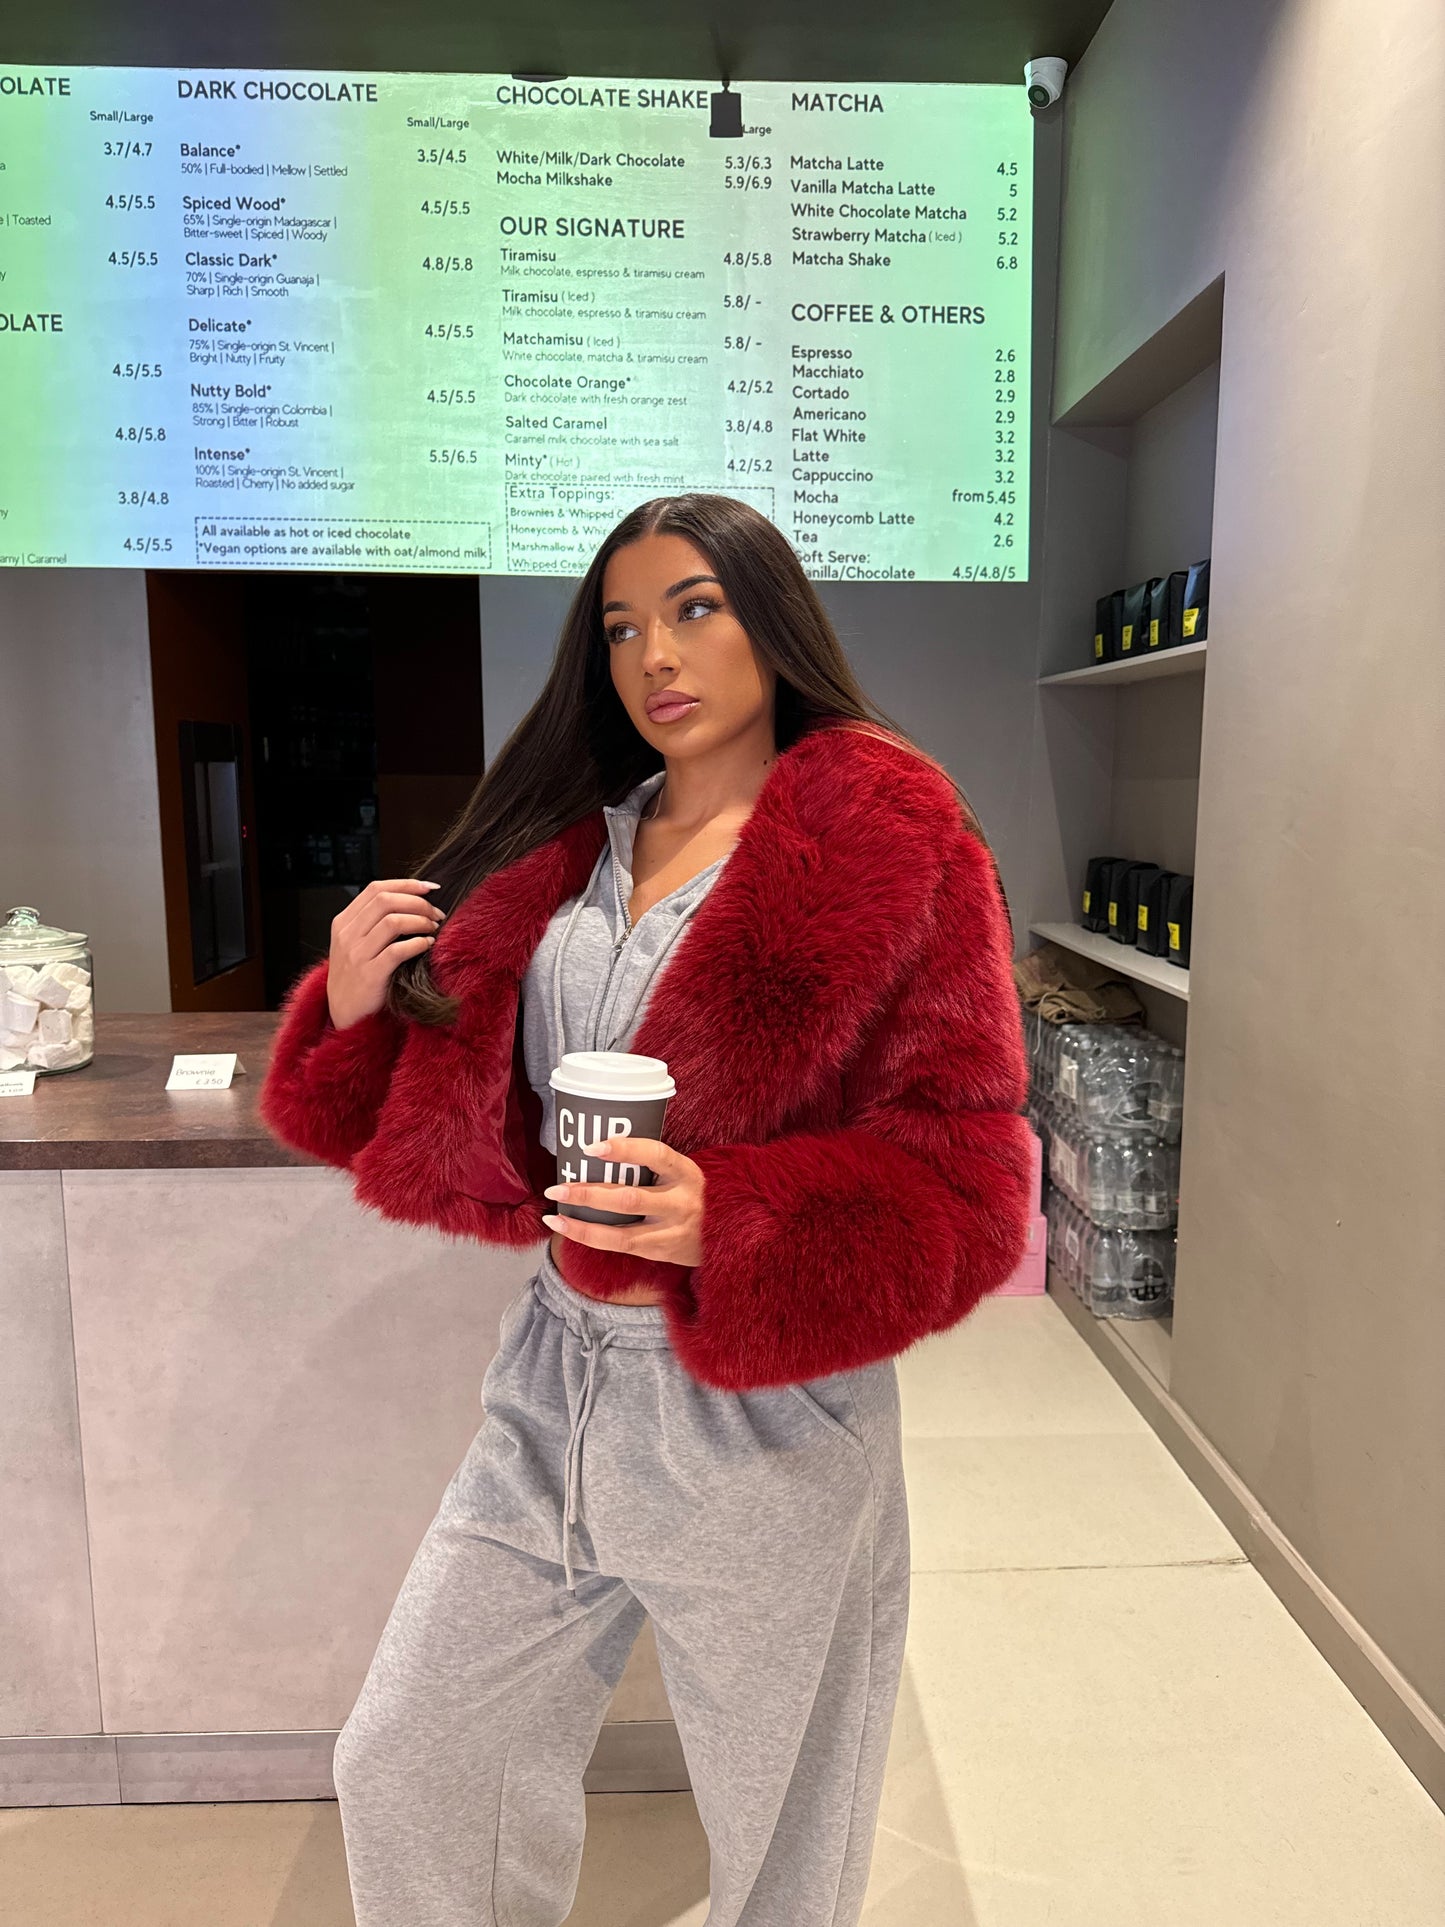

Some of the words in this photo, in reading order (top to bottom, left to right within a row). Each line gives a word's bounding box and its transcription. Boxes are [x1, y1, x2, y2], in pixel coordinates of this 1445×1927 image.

[178, 80, 236, 99] DARK
[244, 81, 377, 102] CHOCOLATE
[497, 86, 630, 107] CHOCOLATE
[638, 89, 708, 109] SHAKE
[792, 93, 883, 112] MATCHA
[90, 111, 153, 125] Small/Large
[407, 117, 469, 131] Small/Large
[104, 142, 152, 158] 3.7/4.7
[418, 148, 466, 165] 3.5/4.5
[496, 150, 611, 167] White/Milk/Dark
[616, 153, 685, 167] Chocolate
[725, 155, 771, 172] 5.3/6.3
[791, 156, 842, 170] Matcha
[848, 157, 884, 170] Latte
[181, 163, 202, 174] 50%
[210, 163, 264, 175] Full-bodied
[272, 164, 306, 175] Mellow
[314, 165, 347, 176] Settled
[997, 162, 1017, 176] 4.5
[497, 171, 541, 184] Mocha
[546, 172, 613, 186] Milkshake
[725, 175, 771, 191] 5.9/6.9
[791, 179, 836, 193] Vanilla
[842, 181, 893, 194] Matcha
[899, 182, 935, 195] Latte
[1010, 184, 1017, 197] 5
[106, 194, 155, 211] 4.5/5.5
[183, 196, 231, 213] Spiced
[421, 200, 470, 216] 4.5/5.5
[791, 203, 834, 217] White
[839, 204, 910, 219] Chocolate
[915, 206, 966, 219] Matcha
[997, 208, 1016, 221] 5.2
[184, 214, 205, 225] 65%
[212, 215, 272, 229] Single-origin
[274, 216, 331, 231] Madagascar
[500, 216, 547, 236] OUR
[556, 218, 684, 238] SIGNATURE
[184, 227, 243, 238] Bitter-sweet
[251, 228, 284, 241] Spiced
[291, 228, 327, 242] Woody
[792, 227, 870, 245] Strawberry
[875, 228, 926, 242] Matcha
[999, 232, 1018, 245] 5.2
[109, 251, 158, 268] 4.5/5.5
[186, 252, 234, 266] Classic
[500, 248, 556, 262] Tiramisu
[724, 252, 772, 268] 4.8/5.8
[793, 251, 843, 265] Matcha
[849, 252, 891, 266] Shake
[997, 256, 1017, 269] 6.8
[423, 256, 473, 273] 4.8/5.8
[501, 265, 520, 276] Milk
[576, 269, 620, 279] espresso
[634, 269, 671, 278] tiramisu
[675, 271, 705, 279] cream
[186, 271, 207, 283] 70%
[215, 272, 274, 286] Single-origin
[276, 273, 314, 287] Guanaja
[187, 284, 215, 298] Sharp
[223, 285, 243, 296] Rich
[251, 285, 289, 297] Smooth
[502, 289, 558, 302] Tiramisu
[792, 304, 873, 322] COFFEE
[880, 305, 895, 323] &
[902, 306, 985, 324] OTHERS
[425, 324, 473, 340] 4.5/5.5
[504, 332, 583, 345] Matchamisu
[792, 345, 852, 362] Espresso
[996, 349, 1015, 362] 2.6
[113, 363, 162, 380] 4.5/5.5
[793, 365, 864, 379] Macchiato
[995, 370, 1015, 383] 2.8
[504, 375, 572, 388] Chocolate
[728, 379, 773, 395] 4.2/5.2
[191, 384, 230, 400] Nutty
[427, 389, 475, 405] 4.5/5.5
[505, 392, 526, 402] Dark
[530, 393, 577, 404] chocolate
[580, 394, 601, 404] with
[604, 394, 628, 404] fresh
[667, 397, 687, 405] zest
[792, 386, 849, 399] Cortado
[996, 389, 1015, 403] 2.9
[793, 407, 866, 420] Americano
[996, 410, 1015, 423] 2.9
[193, 415, 225, 429] Strong
[233, 415, 257, 426] Bitter
[266, 416, 298, 427] Robust
[506, 415, 547, 428] Salted
[553, 416, 607, 429] Caramel
[726, 419, 773, 435] 3.8/4.8
[115, 427, 166, 443] 4.8/5.8
[792, 428, 818, 442] Flat
[823, 429, 866, 442] White
[996, 431, 1014, 444] 3.2
[430, 449, 477, 465] 5.5/6.5
[793, 449, 829, 462] Latte
[995, 449, 1014, 462] 3.2
[727, 458, 772, 474] 4.2/5.2
[792, 468, 873, 485] Cappuccino
[995, 470, 1014, 483] 3.2
[119, 491, 169, 507] 3.8/4.8
[510, 484, 544, 498] Extra
[549, 485, 614, 503] Toppings:
[794, 490, 838, 503] Mocha
[952, 489, 984, 502] from
[987, 491, 1015, 504] 5.45
[511, 507, 554, 517] Brownies
[568, 508, 614, 520] Whipped
[793, 510, 874, 527] Honeycomb
[879, 511, 915, 524] Latte
[994, 513, 1013, 525] 4.2
[202, 525, 216, 536] All
[220, 525, 270, 537] available
[274, 529, 286, 537] as
[290, 526, 309, 537] hot
[312, 530, 324, 538] or
[328, 527, 351, 538] iced
[355, 528, 411, 539] chocolate
[511, 524, 568, 536] Honeycomb
[793, 530, 817, 543] Tea
[124, 537, 172, 554] 4.5/5.5
[512, 541, 574, 552] Marshmallow
[994, 534, 1013, 547] 2.6
[244, 543, 287, 557] options
[290, 547, 308, 555] are
[312, 544, 362, 556] available
[365, 546, 391, 556] with
[394, 546, 460, 559] oat/almond
[464, 547, 486, 558] milk
[828, 551, 870, 563] Serve:
[801, 565, 915, 580] anilla/Chocolate
[952, 565, 1015, 582] 4.5/4.8/5
